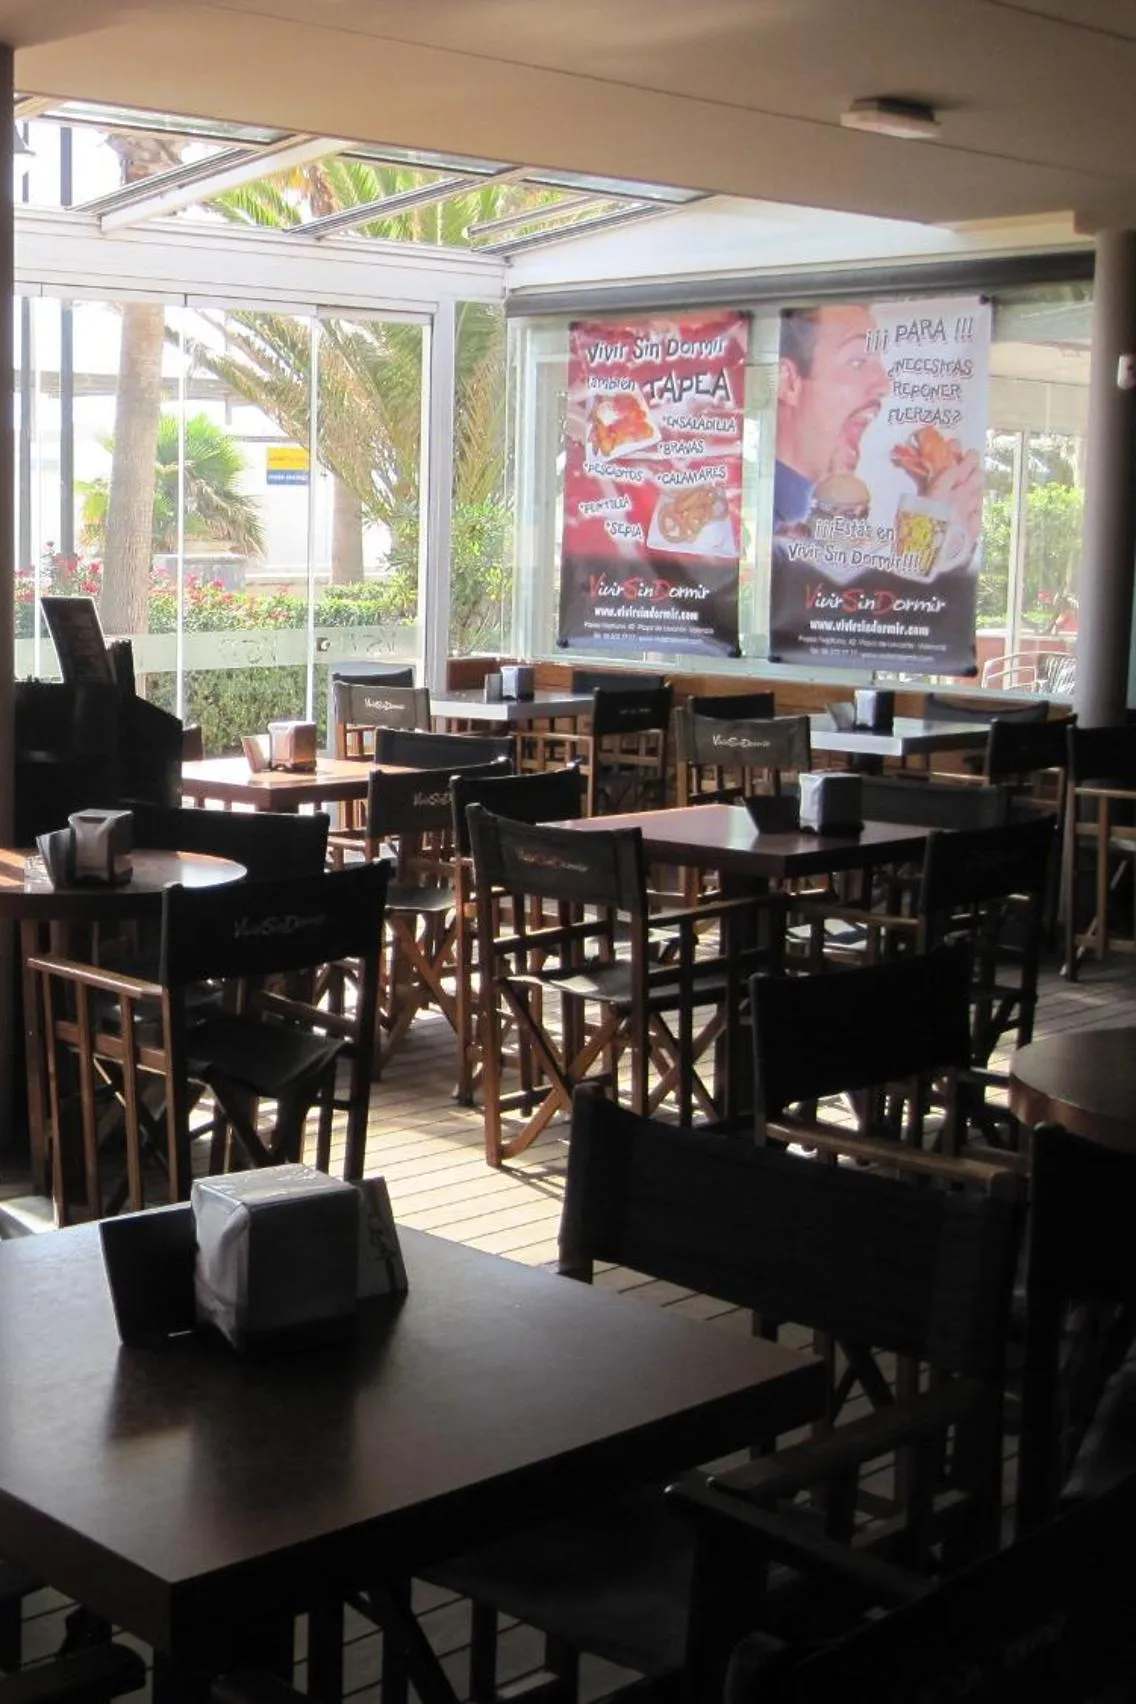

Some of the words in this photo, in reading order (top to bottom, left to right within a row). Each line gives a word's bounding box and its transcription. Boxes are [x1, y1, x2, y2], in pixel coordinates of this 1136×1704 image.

[895, 318, 946, 342] PARA
[588, 342, 626, 364] Vivir
[633, 337, 661, 360] Sin
[667, 336, 726, 358] Dormir
[645, 367, 732, 403] TAPEA
[893, 381, 961, 399] REPONER
[611, 521, 643, 538] SEPIA
[824, 544, 847, 564] Sin
